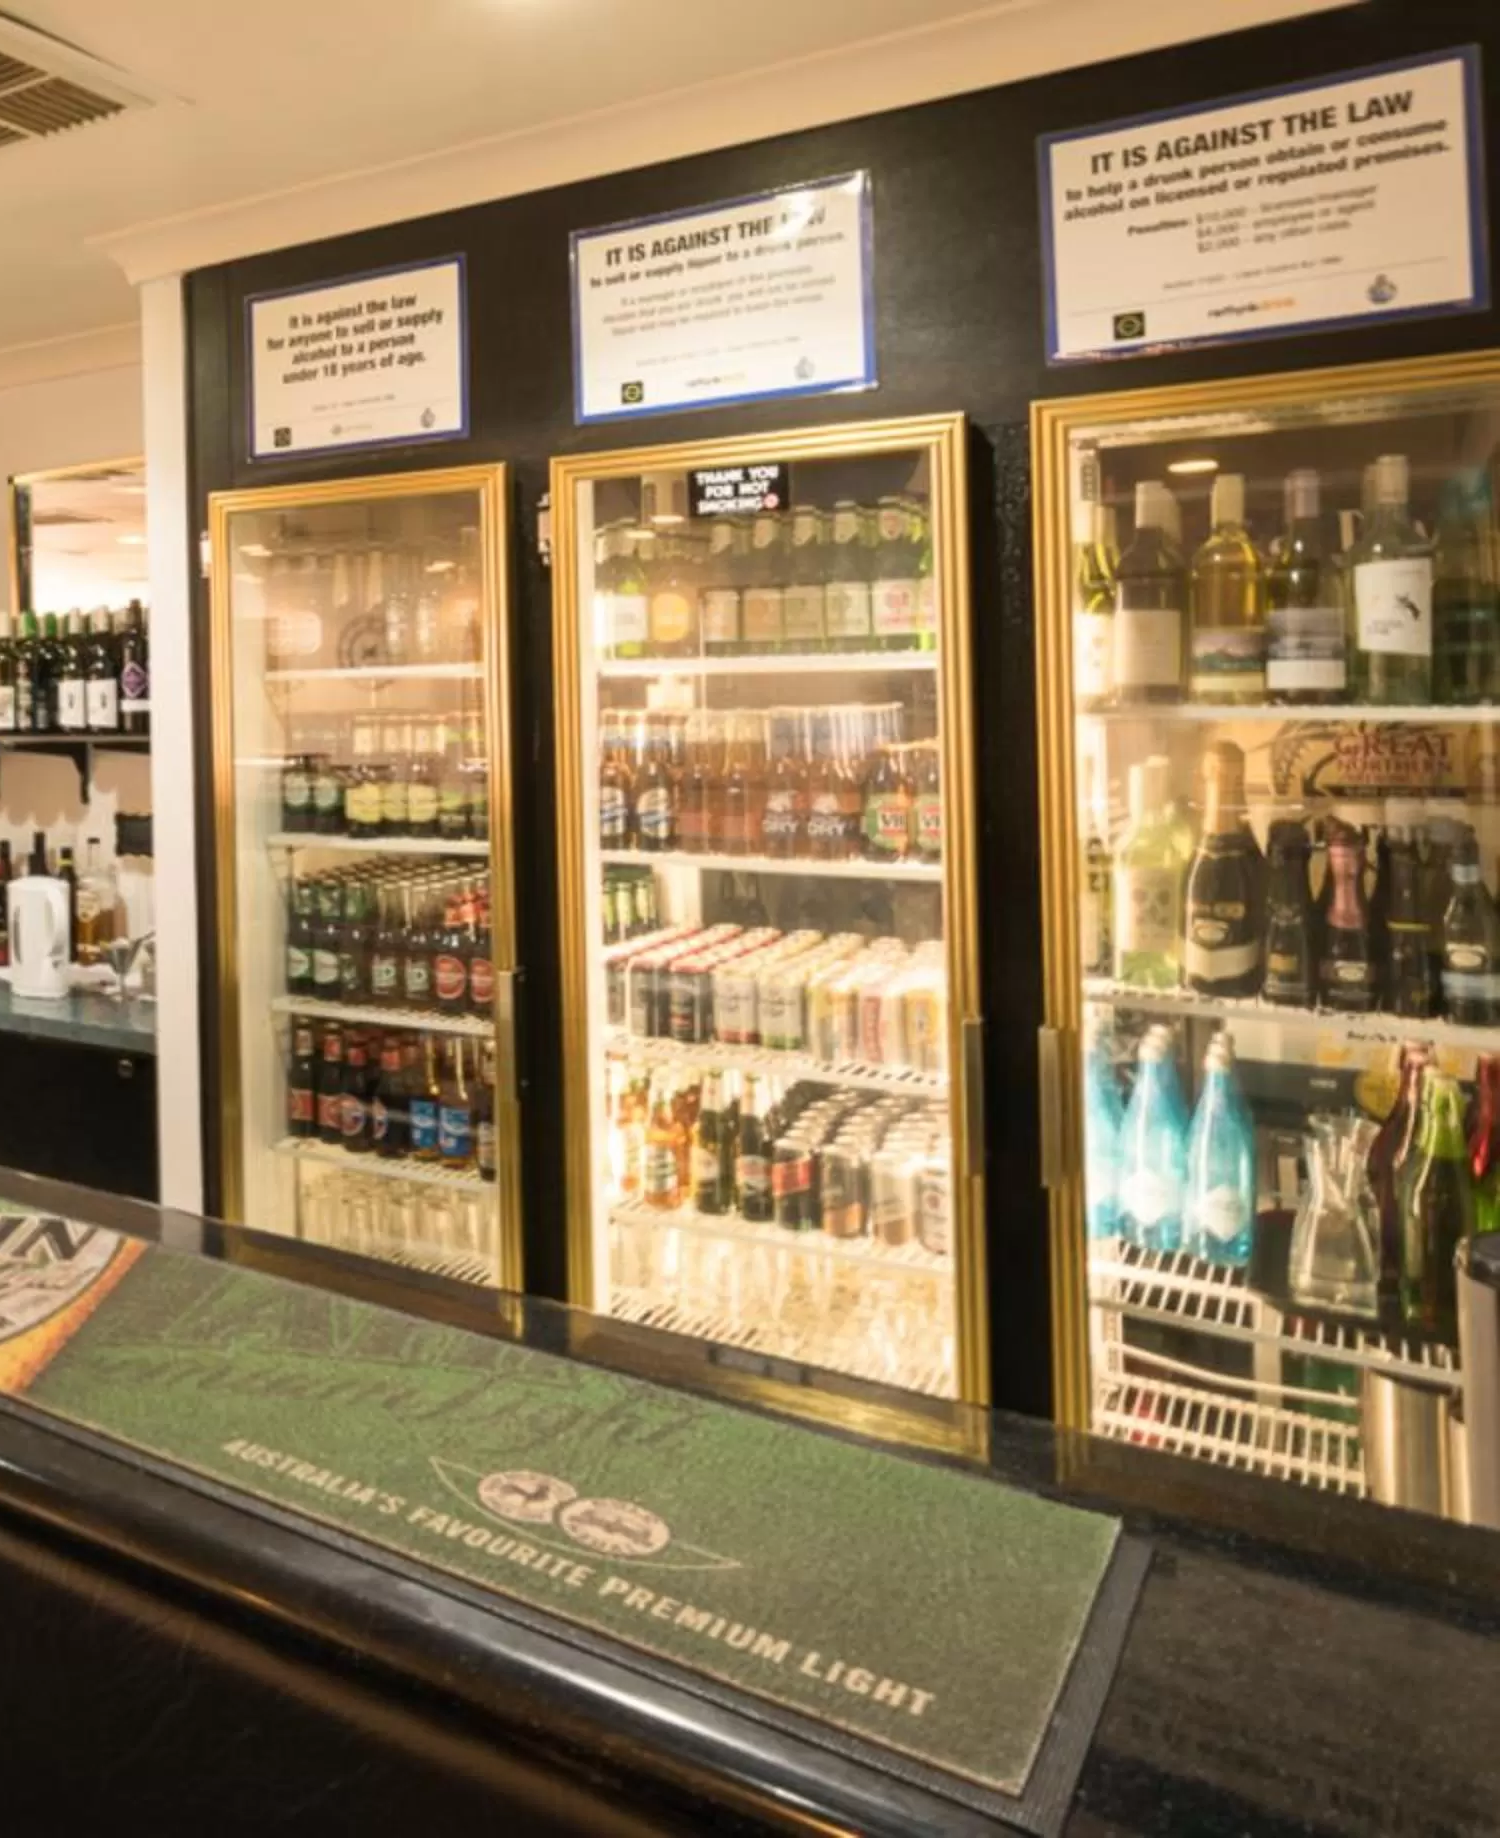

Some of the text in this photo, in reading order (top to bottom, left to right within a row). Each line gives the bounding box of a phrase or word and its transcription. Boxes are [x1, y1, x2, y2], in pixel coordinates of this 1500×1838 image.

[1091, 90, 1414, 175] IT IS AGAINST THE LAW
[1065, 119, 1447, 201] to help a drunk person obtain or consume
[1063, 141, 1452, 222] alcohol on licensed or regulated premises.
[605, 247, 622, 267] IT
[628, 243, 646, 262] IS
[651, 224, 732, 258] AGAINST
[267, 307, 443, 351] for anyone to sell or supply
[315, 302, 362, 325] against
[366, 300, 387, 314] the
[391, 295, 416, 309] law
[292, 344, 337, 365] alcohol
[341, 343, 353, 356] to
[369, 332, 415, 353] person
[283, 367, 318, 384] under
[323, 363, 338, 376] 18
[341, 359, 375, 378] years
[380, 352, 393, 367] of
[696, 465, 779, 486] THANK YOU
[705, 480, 770, 499] FOR NOT
[697, 495, 763, 515] SMOKING
[223, 1439, 406, 1515] AUSTRALIA'S
[405, 1506, 596, 1588] FAVOURITE
[598, 1576, 792, 1664] PREMIUM
[800, 1651, 936, 1717] LIGHT
